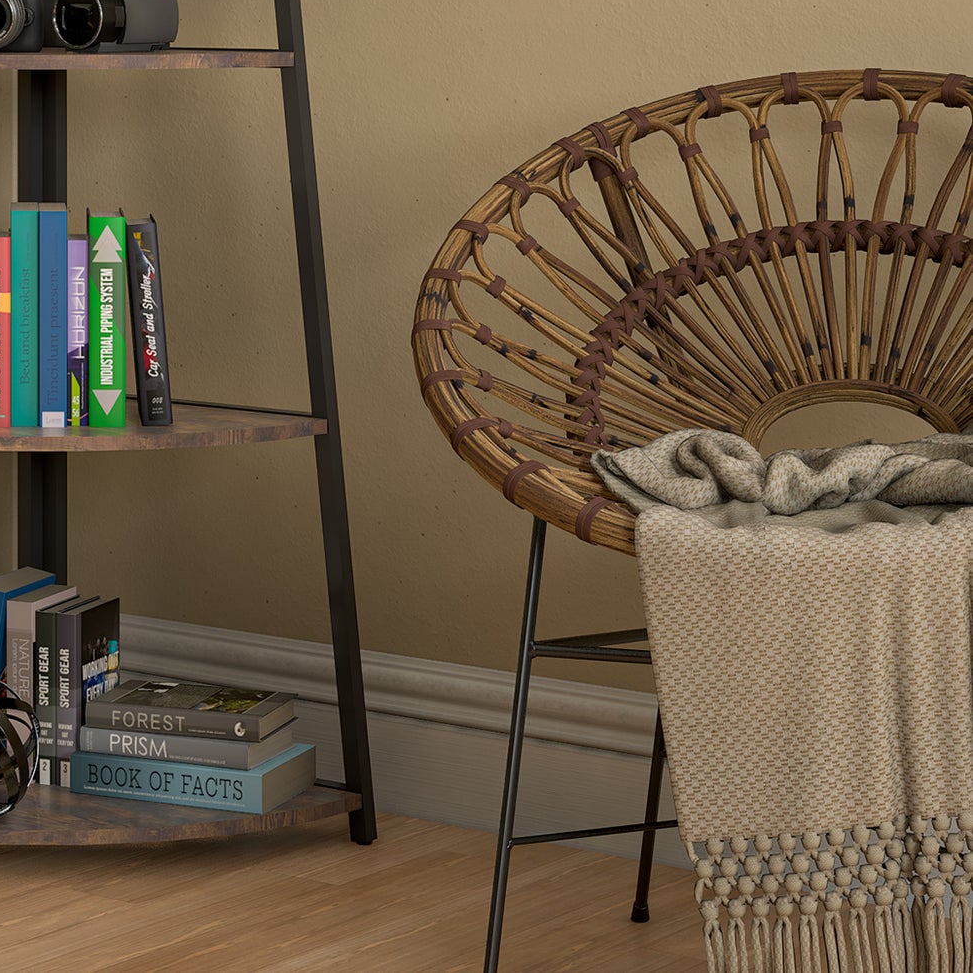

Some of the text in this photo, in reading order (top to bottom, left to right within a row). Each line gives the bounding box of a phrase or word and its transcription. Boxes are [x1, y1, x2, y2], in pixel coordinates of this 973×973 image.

[19, 267, 30, 327] breakfast
[70, 266, 86, 359] HORIZON
[100, 268, 114, 385] INDUSTRIAL PIPING SYSTEM
[137, 274, 159, 378] Car Seat and Stroller
[19, 331, 30, 356] and
[47, 267, 62, 406] Tincidunt praesent
[19, 360, 30, 385] Bed
[18, 638, 30, 699] NATURE
[39, 646, 49, 707] SPORT GEAR
[60, 648, 70, 708] SPORT GEAR
[109, 733, 168, 758] PRISM
[111, 710, 186, 732] FOREST
[42, 761, 47, 771] 2
[62, 764, 68, 773] 3
[87, 763, 142, 789] BOOK
[149, 770, 175, 792] OF
[181, 774, 244, 801] FACTS
